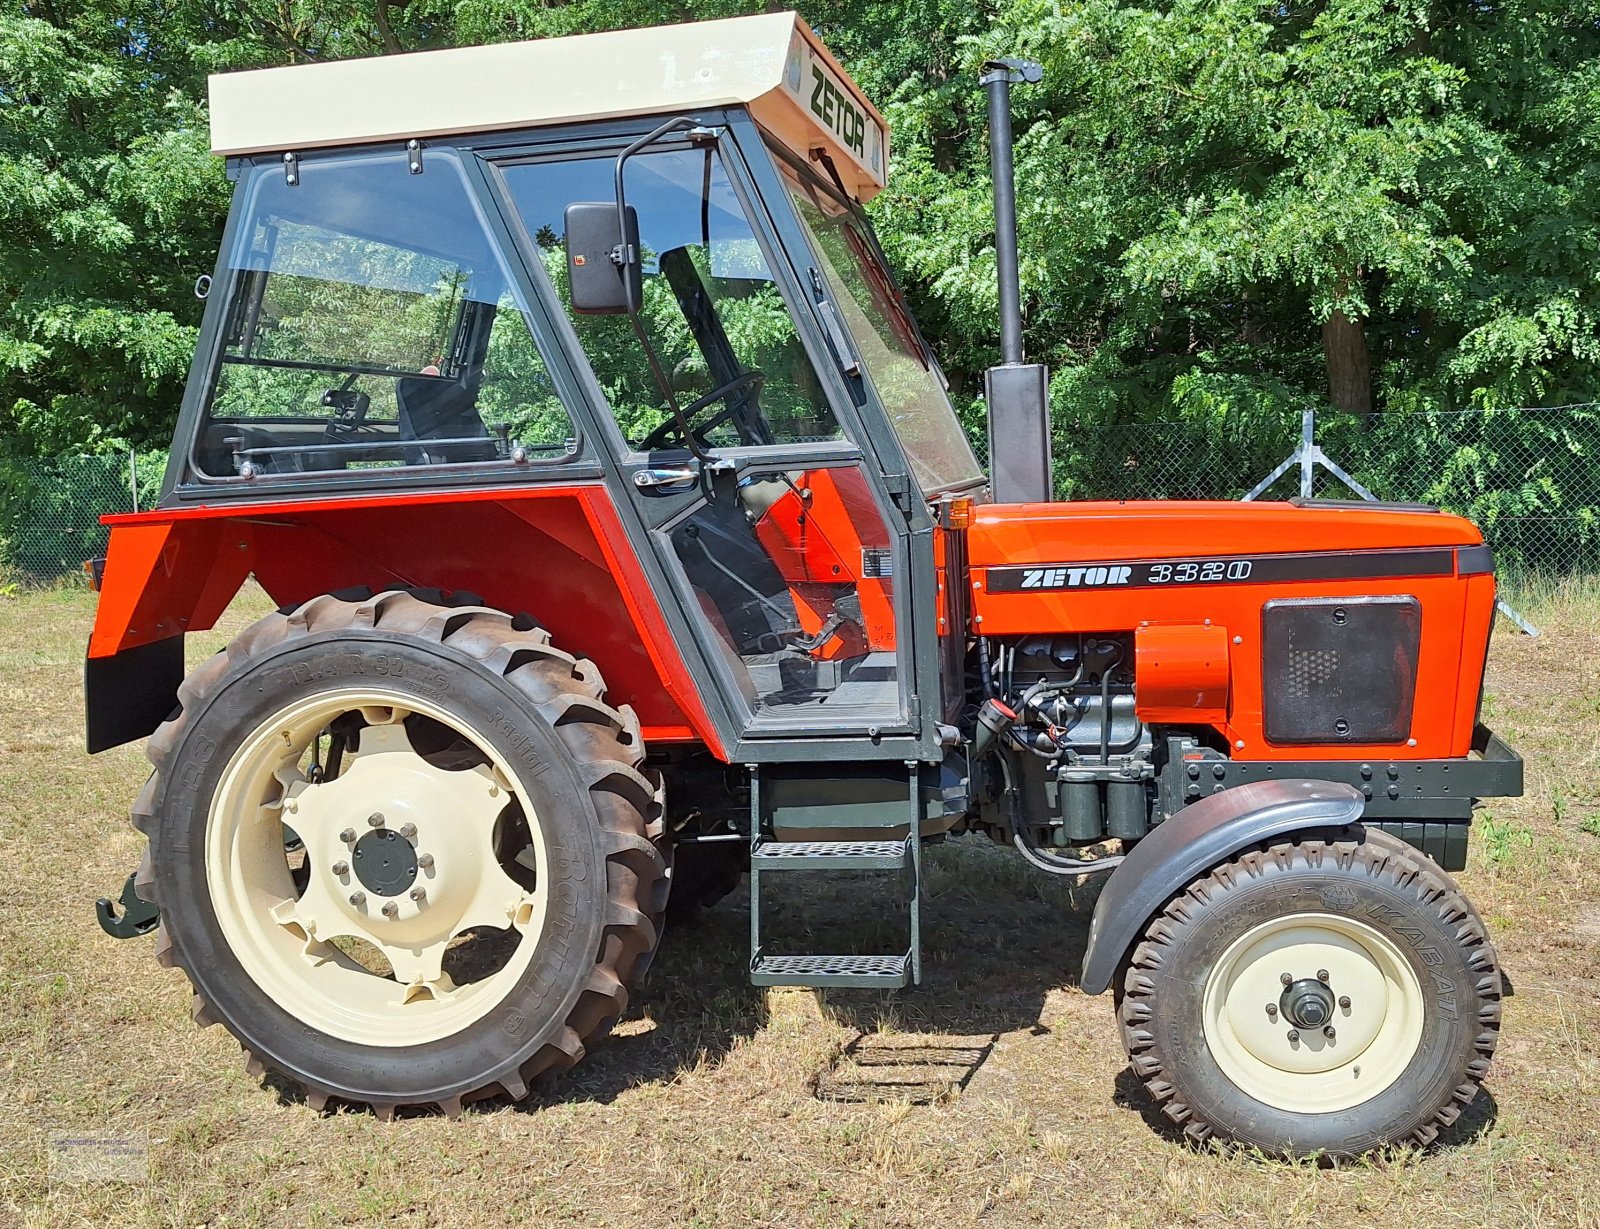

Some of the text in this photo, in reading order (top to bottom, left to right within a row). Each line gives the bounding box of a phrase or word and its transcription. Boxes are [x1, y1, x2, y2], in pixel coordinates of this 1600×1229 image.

[810, 64, 865, 158] ZETOR
[1021, 561, 1253, 588] ZETOR 3320
[485, 706, 552, 777] Radial
[520, 845, 588, 1010] Barum
[1367, 905, 1458, 1020] KABAT
